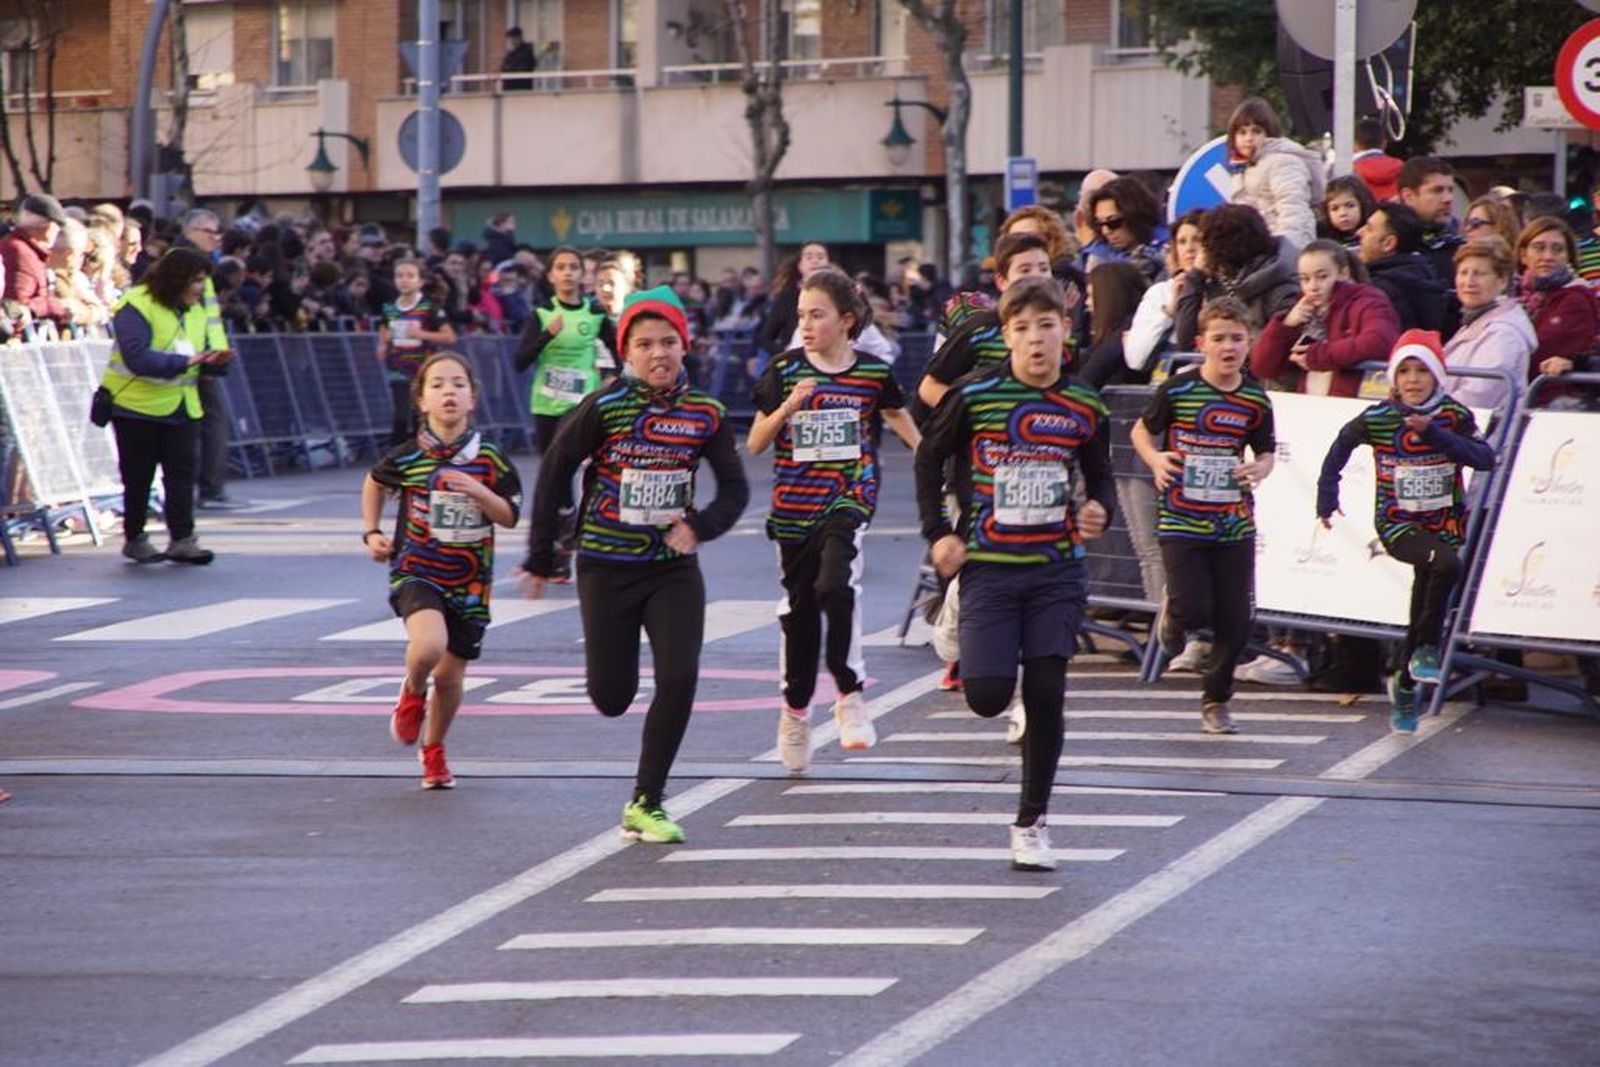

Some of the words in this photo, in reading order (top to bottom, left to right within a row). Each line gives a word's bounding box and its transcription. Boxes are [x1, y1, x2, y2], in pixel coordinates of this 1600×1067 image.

[576, 211, 612, 236] CAJA
[616, 208, 664, 232] RURAL
[668, 208, 690, 231] DE
[691, 205, 790, 231] SALAMAA
[801, 421, 845, 445] 5755
[628, 482, 677, 507] 5884
[1005, 482, 1055, 506] 5805
[1402, 476, 1443, 498] 5856
